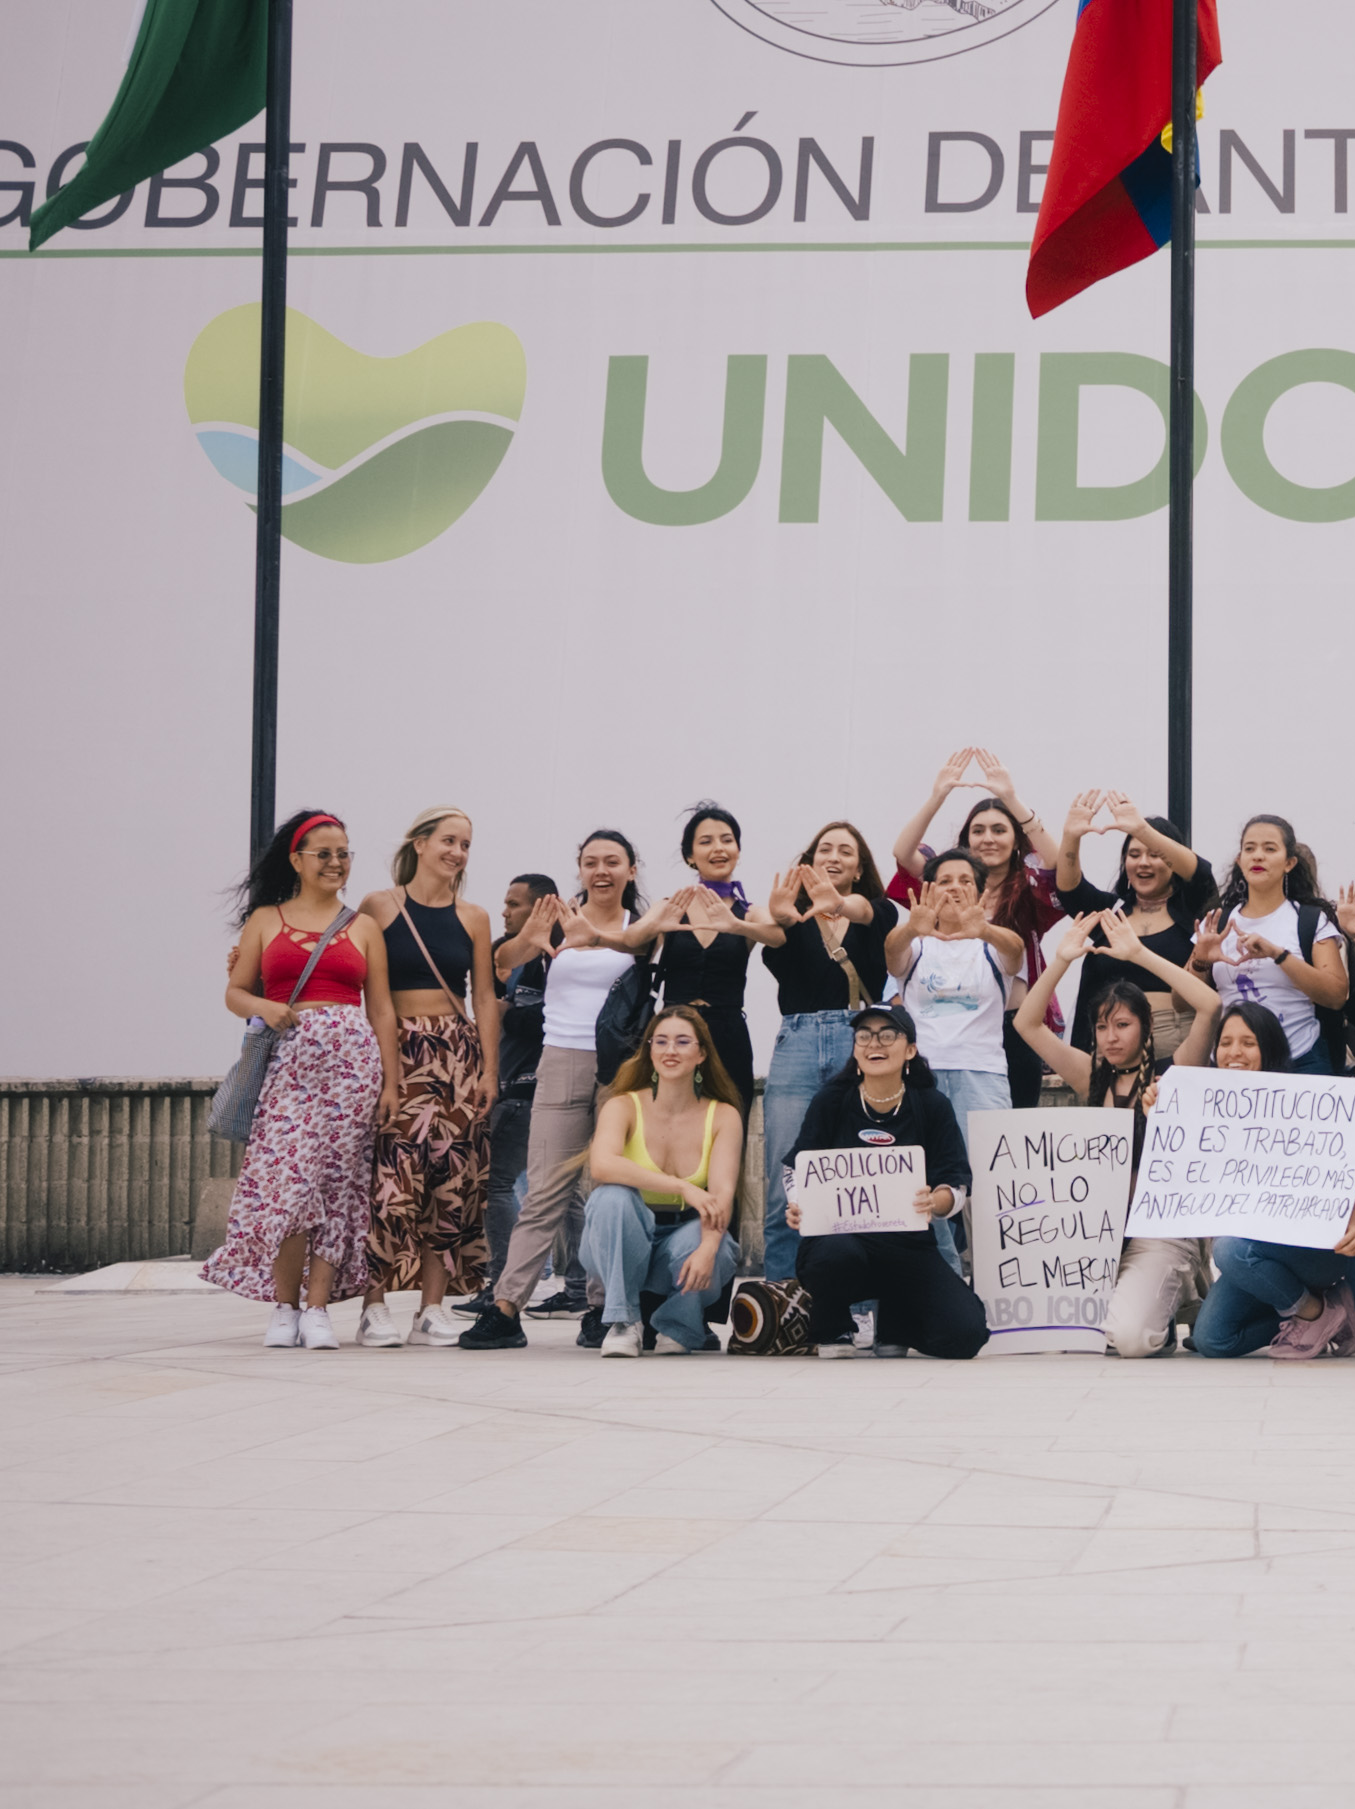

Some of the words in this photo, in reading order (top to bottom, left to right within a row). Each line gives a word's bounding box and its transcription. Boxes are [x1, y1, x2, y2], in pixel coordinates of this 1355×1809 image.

[1154, 1086, 1180, 1115] LA
[988, 1133, 1017, 1172] A
[1024, 1130, 1055, 1172] MI
[1056, 1132, 1130, 1172] CUERPO
[1150, 1125, 1186, 1152] NO
[1199, 1125, 1230, 1153] ES
[1242, 1126, 1348, 1160] TRABAJO,
[803, 1148, 914, 1189] ABOLICIÓN
[1148, 1159, 1174, 1183] ES
[1185, 1160, 1211, 1184] EL
[1218, 1158, 1321, 1188] PRIVILEGIO
[1321, 1162, 1355, 1191] MÁS
[835, 1183, 881, 1219] ¡YA!
[996, 1179, 1039, 1212] NO
[1050, 1175, 1090, 1204] LO
[1133, 1191, 1216, 1220] ANTIGUO
[1215, 1192, 1251, 1218] DEL
[1253, 1190, 1351, 1222] PATRIARCADO
[998, 1209, 1115, 1251] REGULA
[998, 1256, 1038, 1289] EL
